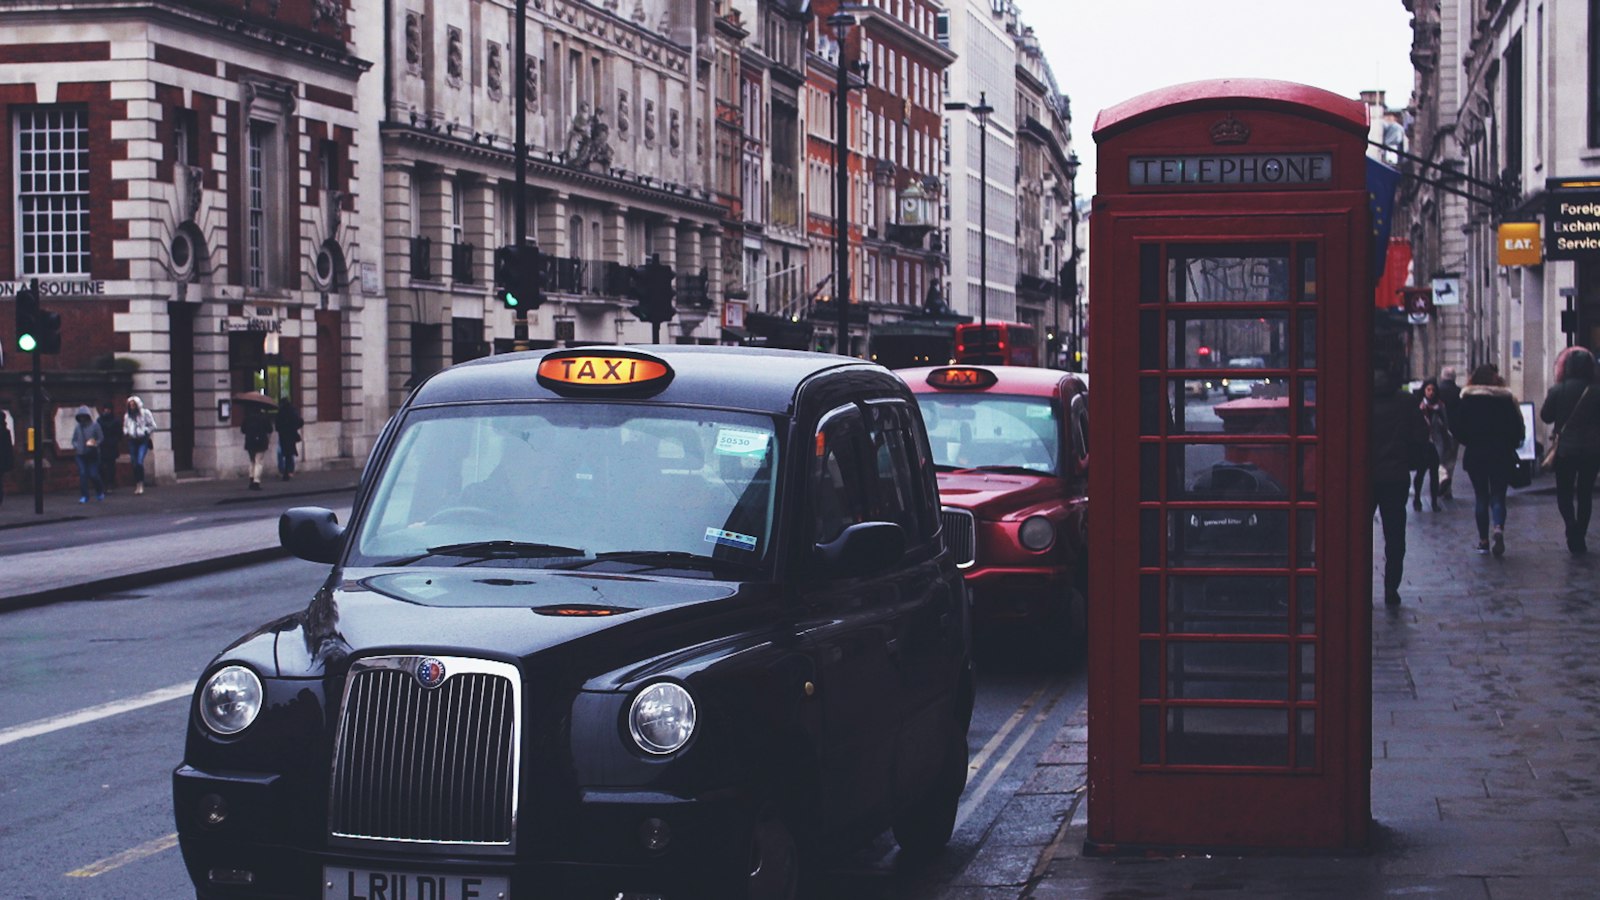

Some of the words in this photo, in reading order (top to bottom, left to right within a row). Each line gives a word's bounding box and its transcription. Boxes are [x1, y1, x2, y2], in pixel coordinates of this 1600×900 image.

[1136, 157, 1324, 184] TELEPHONE
[20, 281, 104, 295] ASOULINE
[561, 360, 636, 380] TAXI
[943, 371, 979, 384] TAXI
